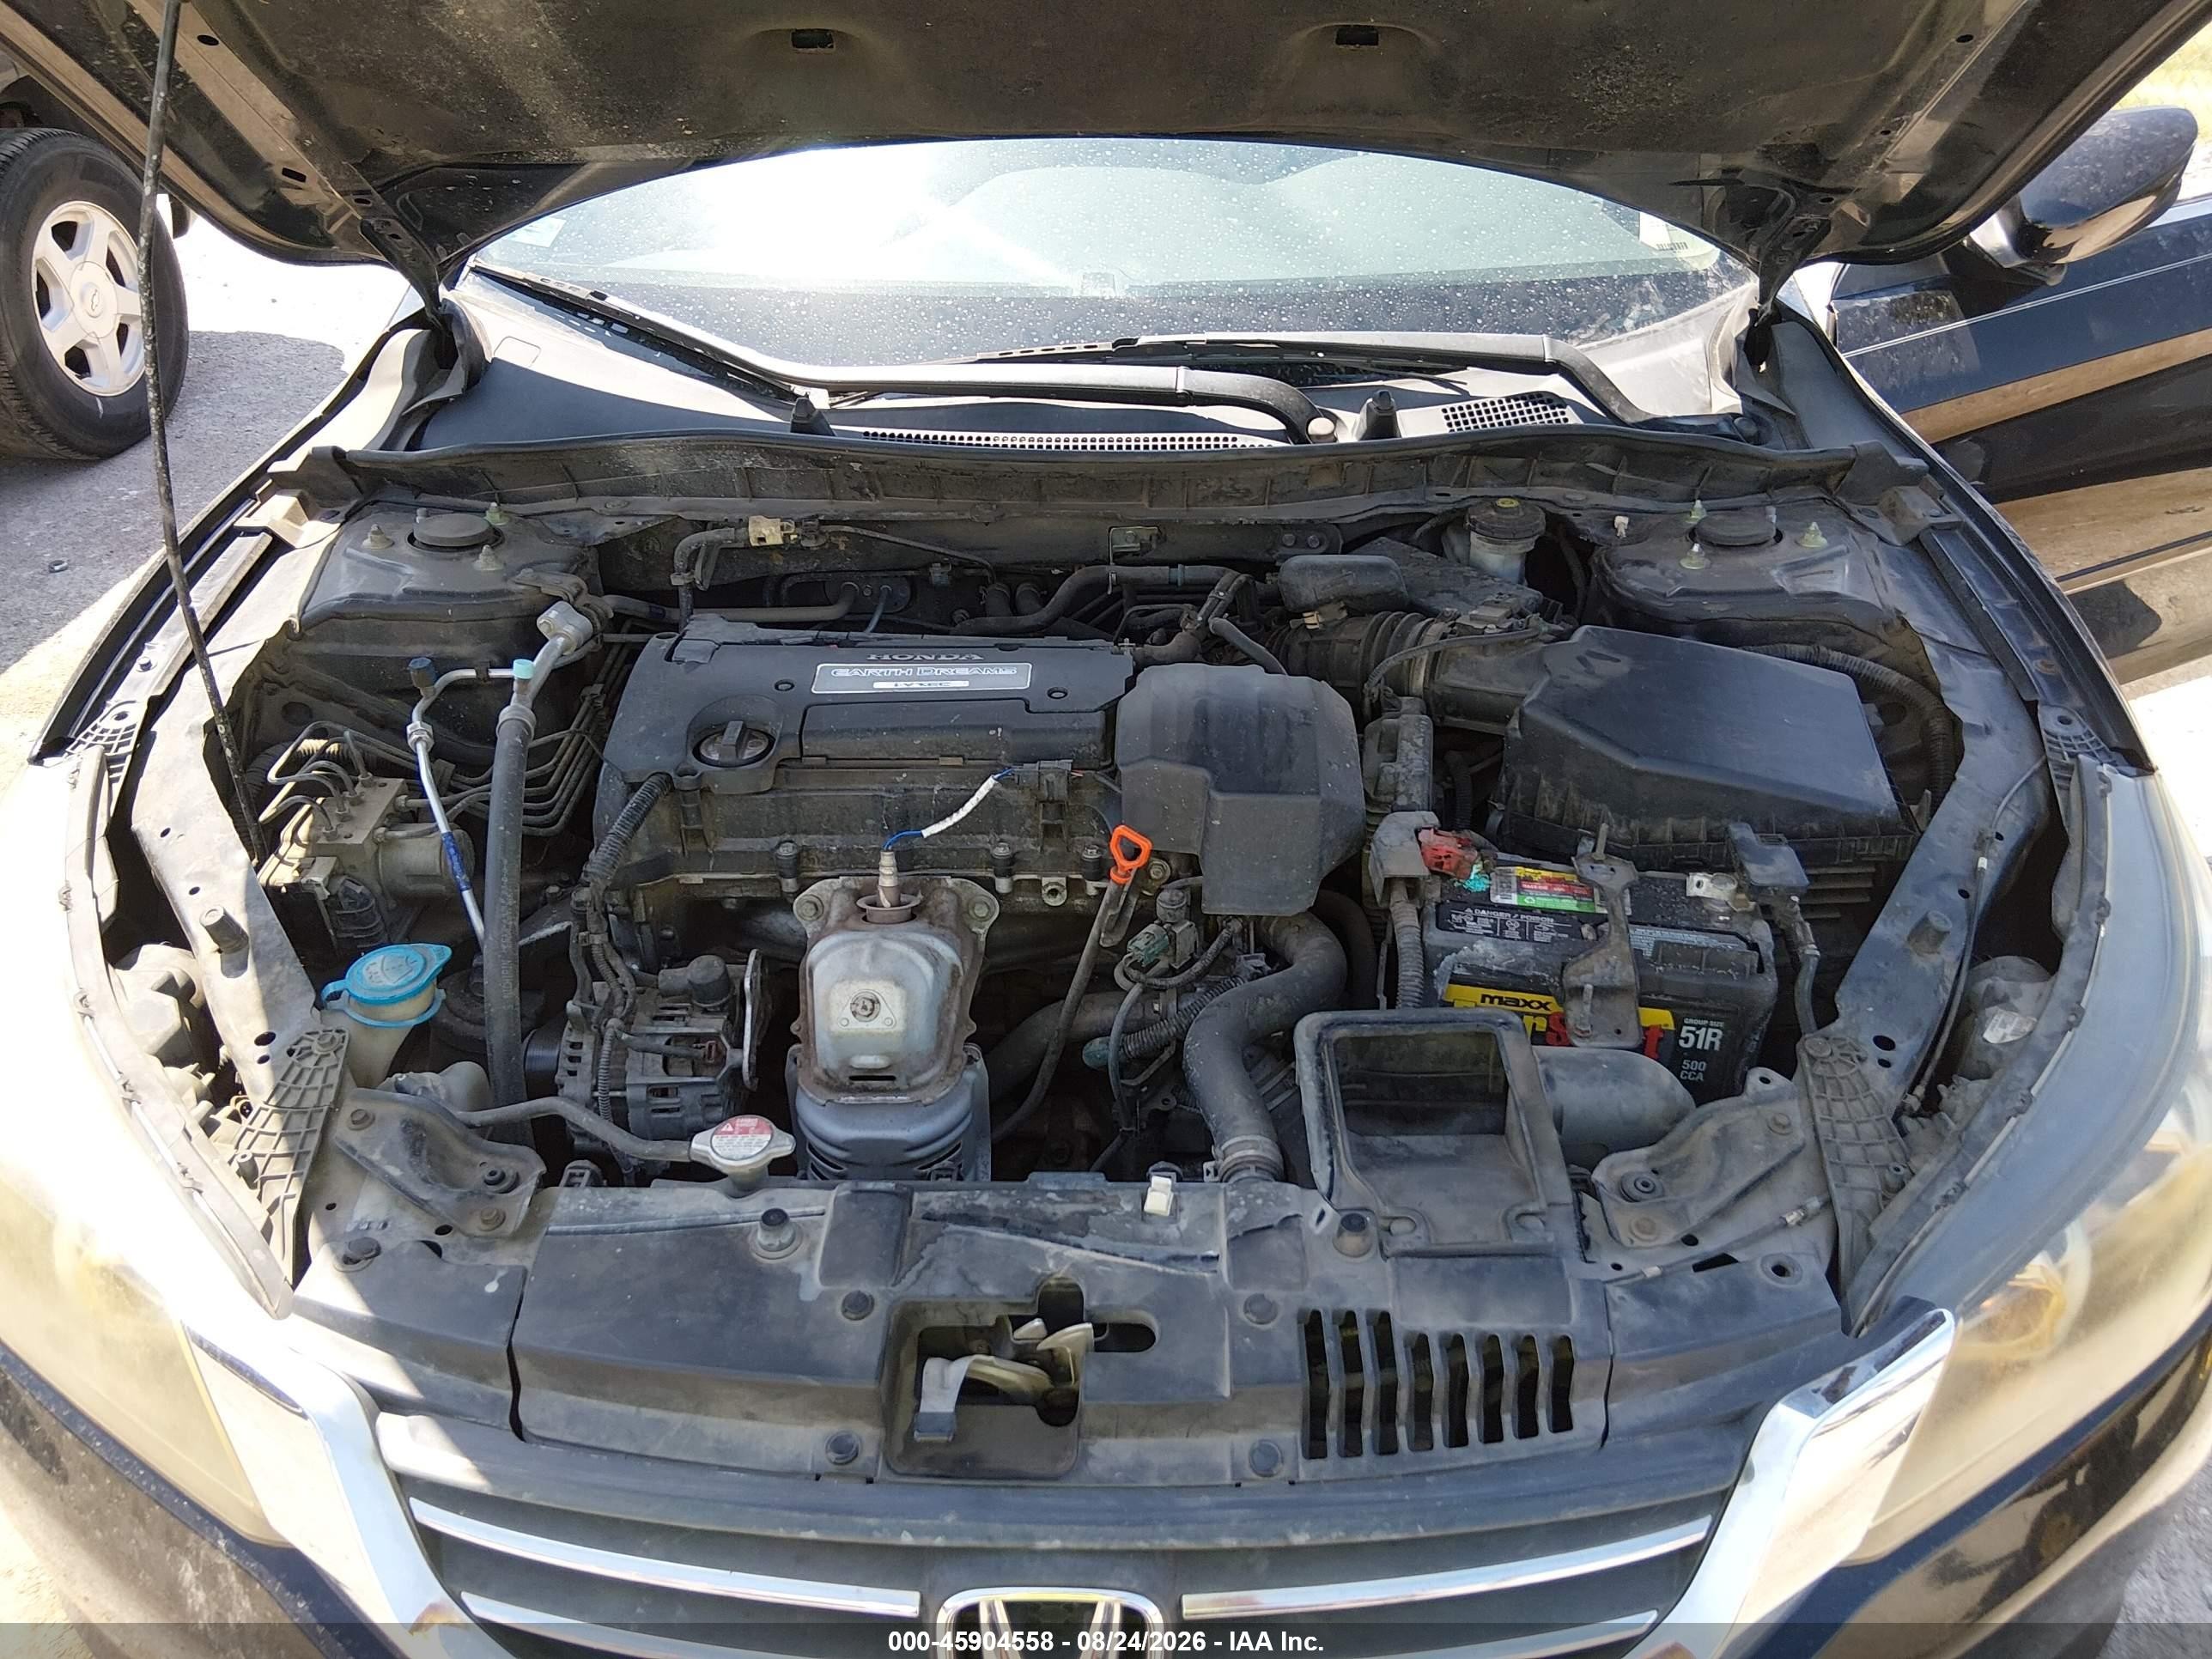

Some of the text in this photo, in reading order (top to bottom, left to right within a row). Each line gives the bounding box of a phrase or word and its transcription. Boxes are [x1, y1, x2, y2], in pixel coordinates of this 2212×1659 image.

[1474, 908, 1511, 918] DANGER
[1480, 994, 1553, 1011] maxx
[1678, 1025, 1723, 1051] 51R
[1681, 1060, 1707, 1072] 500
[1680, 1070, 1705, 1081] CCA
